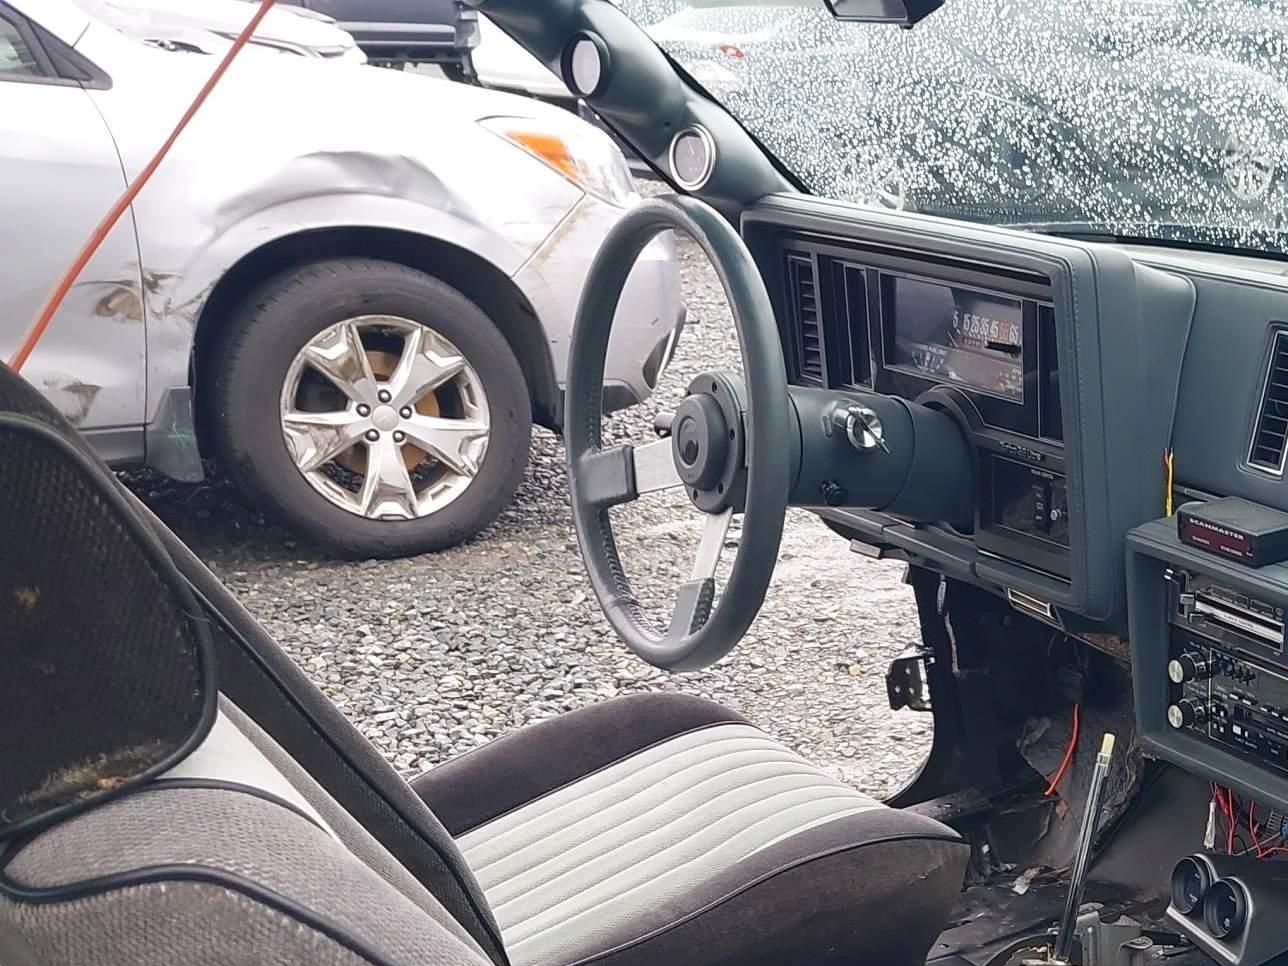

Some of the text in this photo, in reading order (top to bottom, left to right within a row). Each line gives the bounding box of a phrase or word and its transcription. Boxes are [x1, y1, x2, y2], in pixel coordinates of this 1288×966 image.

[971, 315, 980, 333] 25
[990, 320, 999, 338] 45
[1009, 324, 1019, 345] 65
[1189, 517, 1244, 540] SCANMASTER
